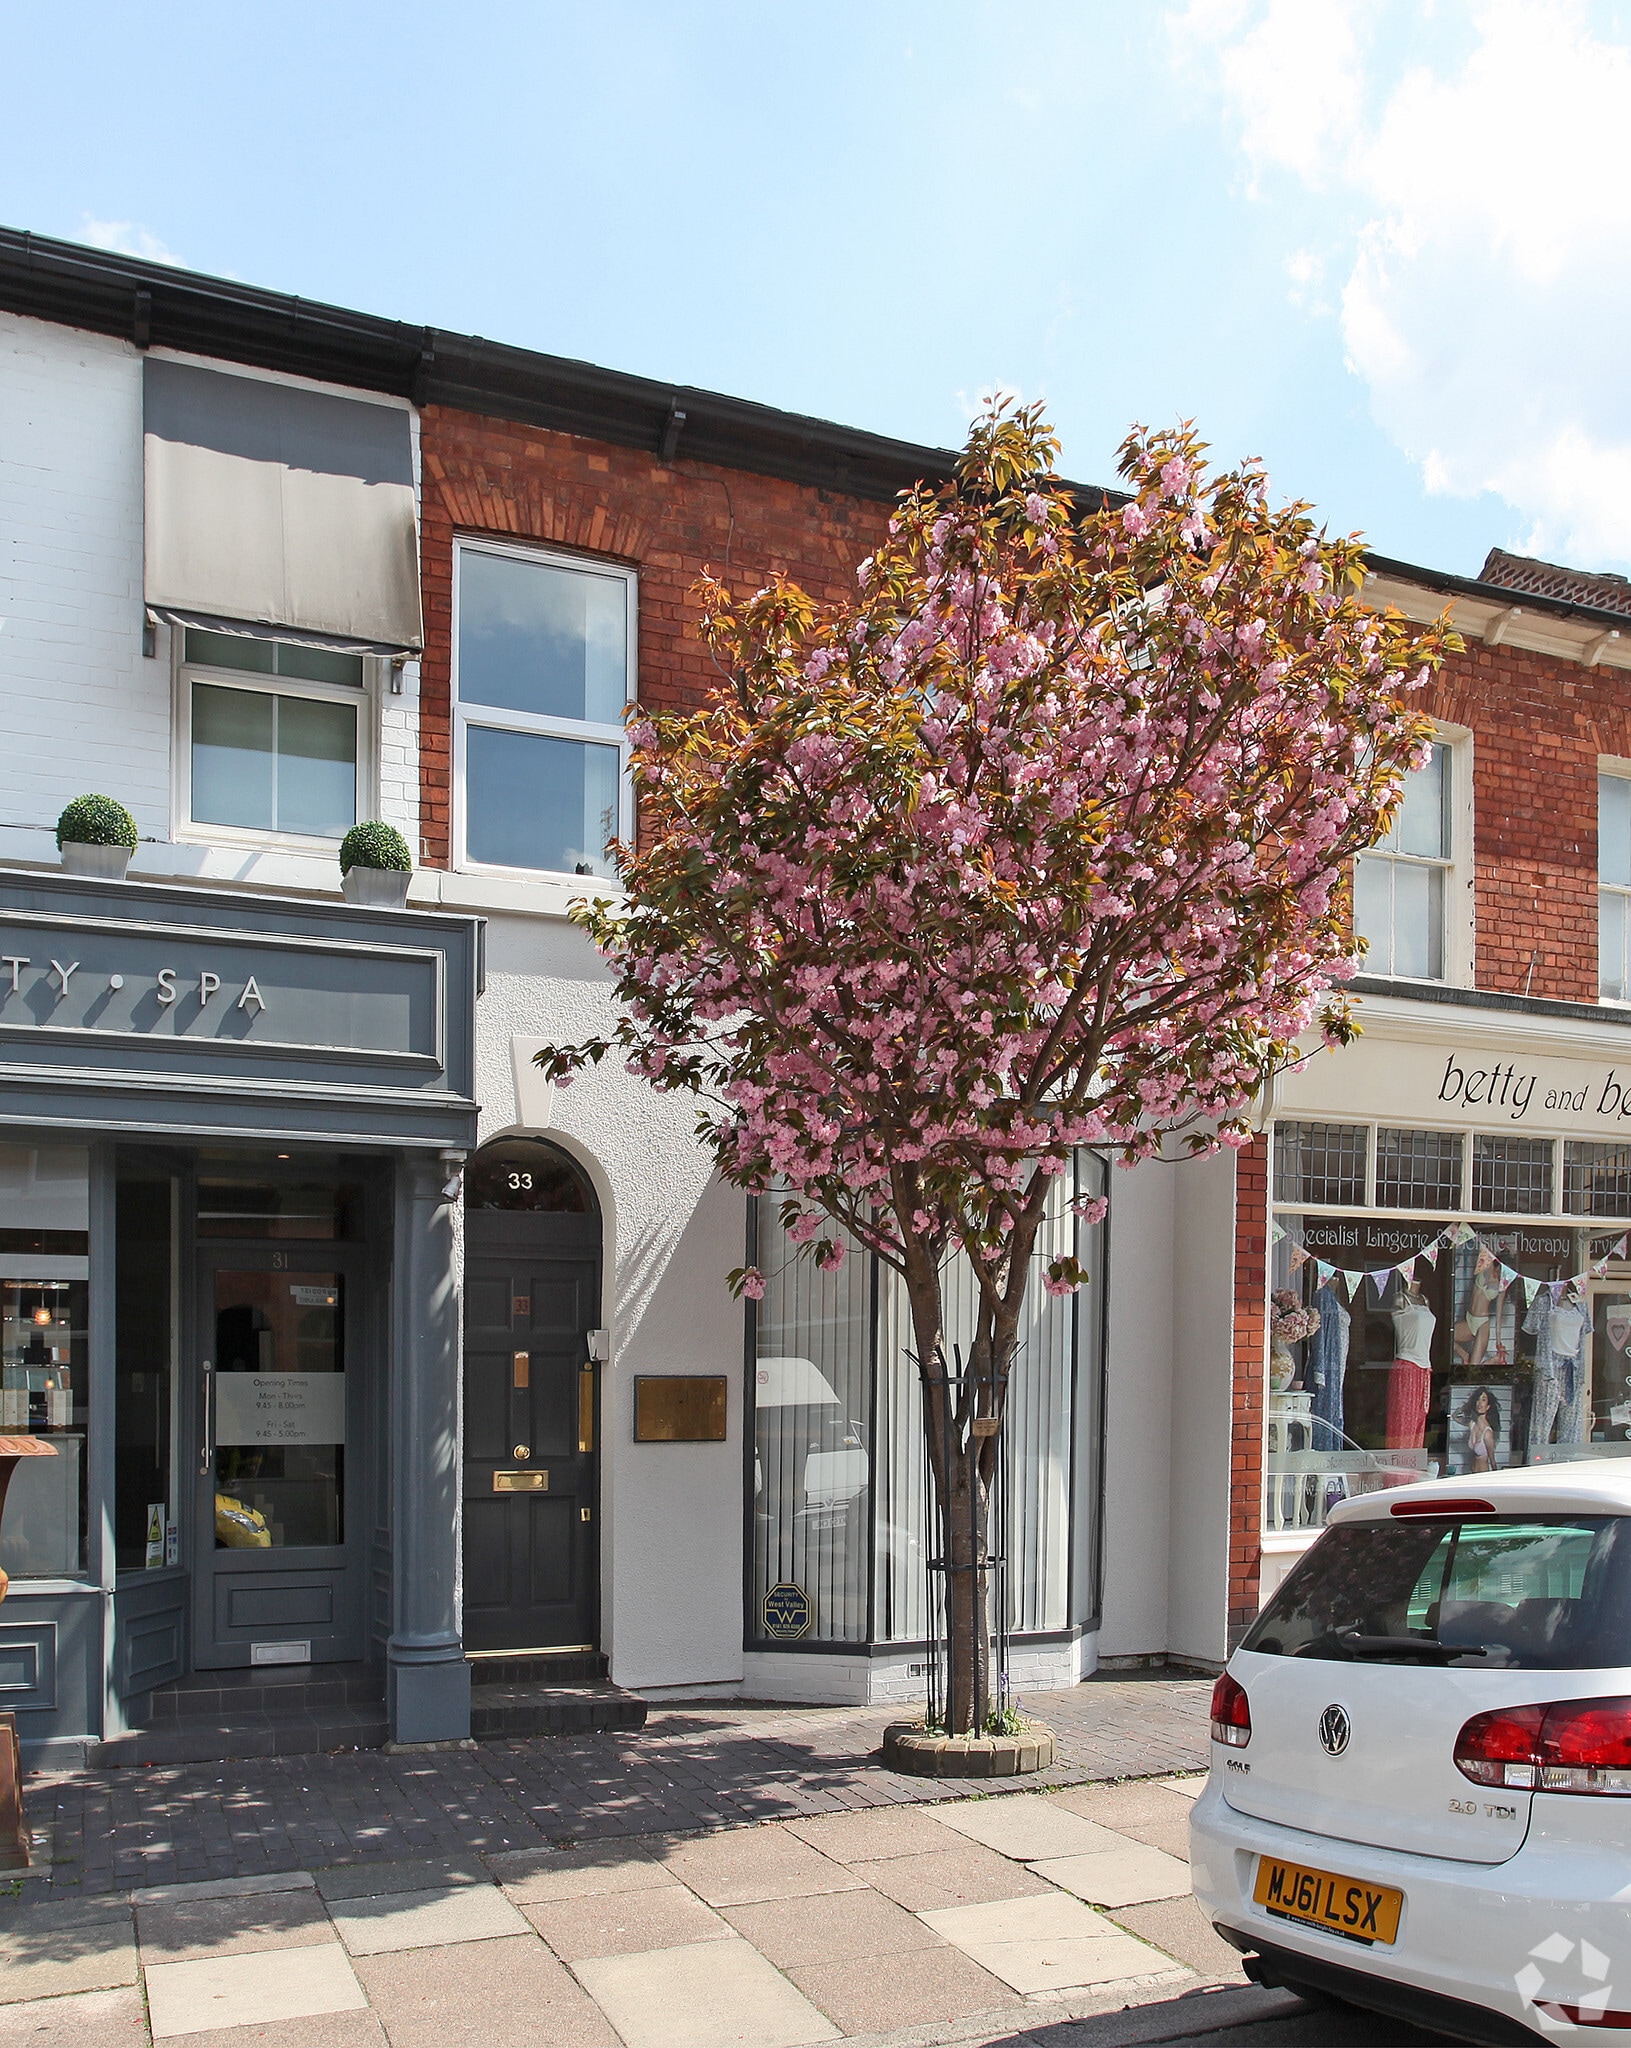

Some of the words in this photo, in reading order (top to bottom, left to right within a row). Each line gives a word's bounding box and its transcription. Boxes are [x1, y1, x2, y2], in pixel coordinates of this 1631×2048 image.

[157, 968, 266, 1011] SPA
[1437, 1053, 1538, 1120] betty
[1544, 1085, 1590, 1111] and
[508, 1172, 533, 1190] 33
[1285, 1222, 1360, 1248] Specialist
[1365, 1226, 1430, 1254] Lingerie
[1511, 1230, 1571, 1259] Therapy
[272, 1251, 289, 1269] 31
[516, 1299, 529, 1312] 33
[253, 1378, 286, 1389] Opening
[287, 1379, 309, 1387] Times
[258, 1392, 276, 1400] Mon
[255, 1402, 272, 1410] 9.45
[278, 1402, 306, 1411] 8.00pm
[267, 1420, 278, 1428] Fri
[283, 1420, 295, 1429] Sat
[255, 1430, 272, 1438] 9.45
[278, 1430, 306, 1439] 5.00pm
[768, 1600, 784, 1608] West
[785, 1601, 805, 1610] Valley
[1448, 1798, 1478, 1817] 2.0
[1483, 1803, 1517, 1821] TDI
[1267, 1865, 1322, 1915] MJ61
[1324, 1881, 1383, 1933] LSX
